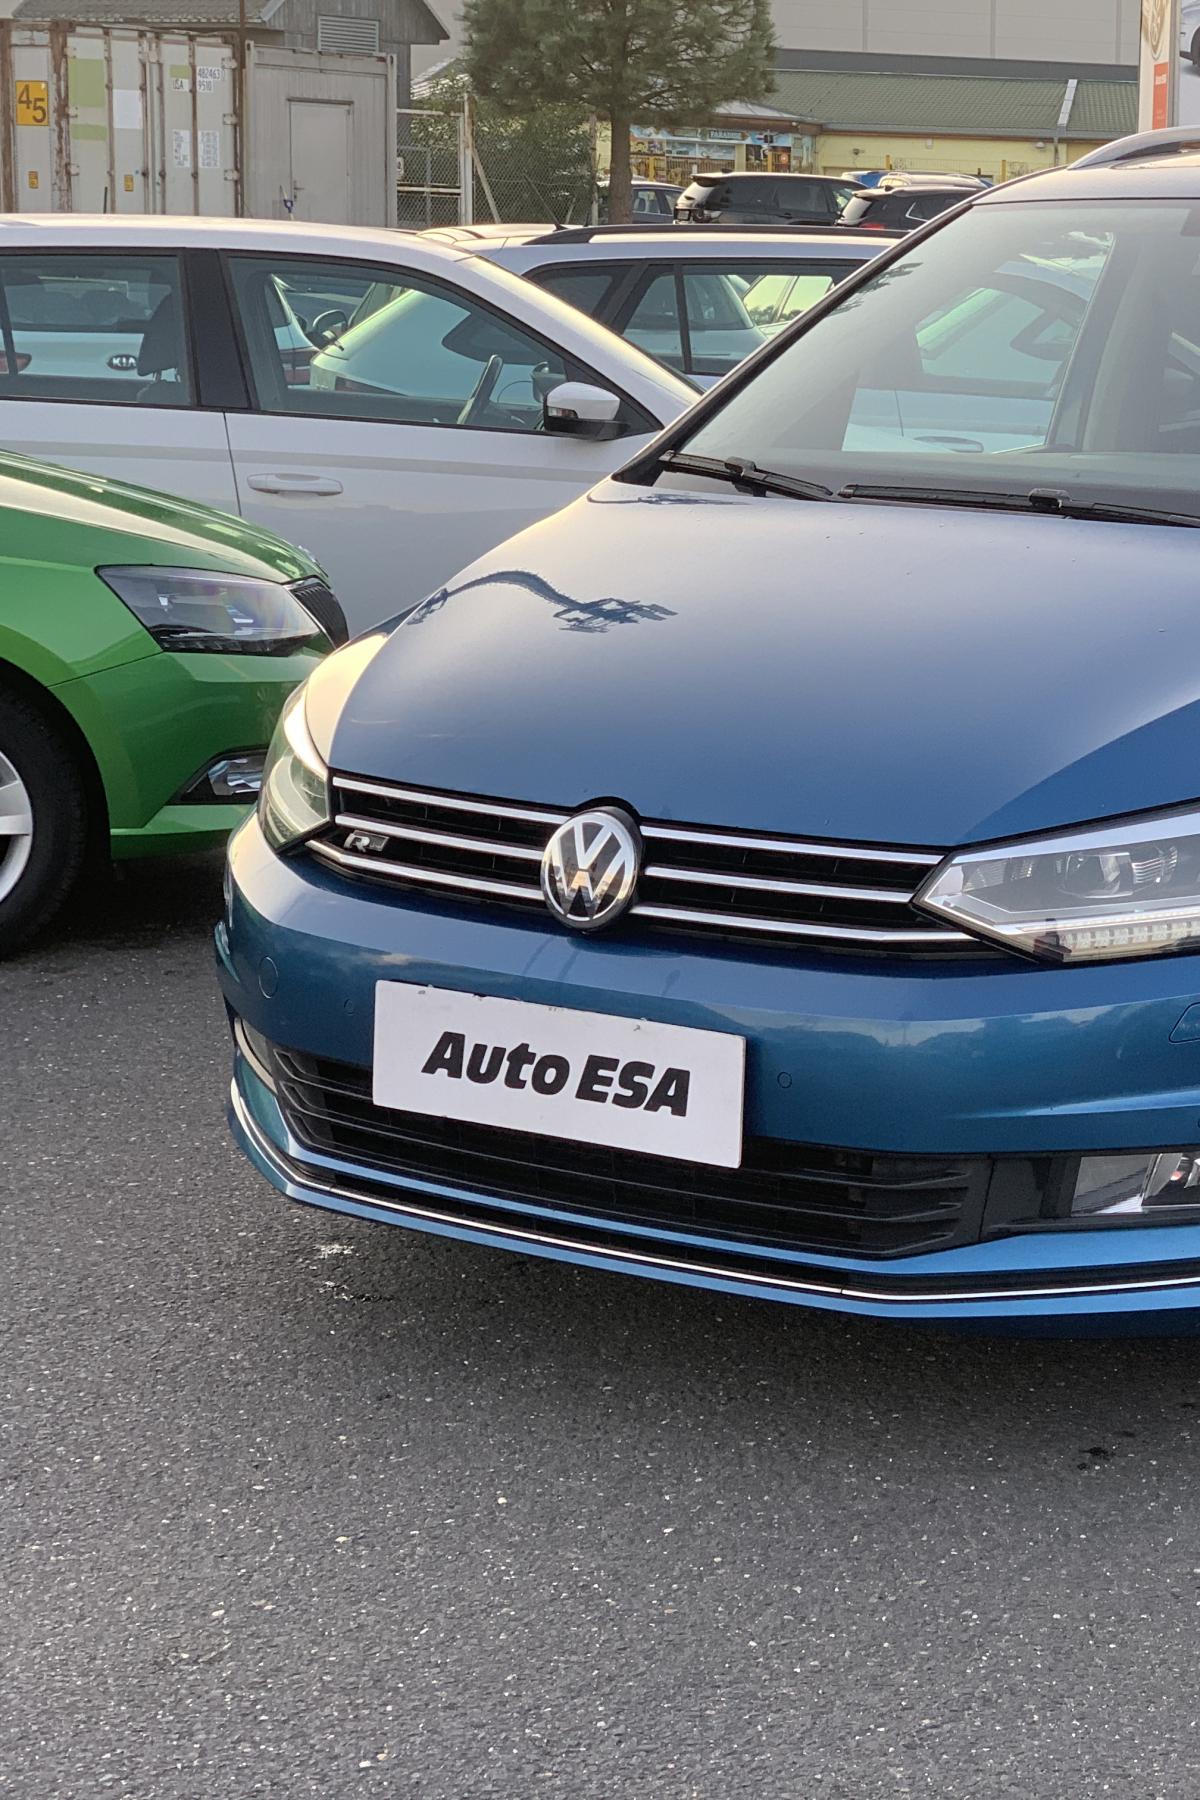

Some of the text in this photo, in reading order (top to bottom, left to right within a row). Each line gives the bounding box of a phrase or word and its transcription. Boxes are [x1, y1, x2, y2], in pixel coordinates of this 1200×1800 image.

[112, 356, 136, 367] KIA
[421, 1030, 691, 1118] Auto ESA
